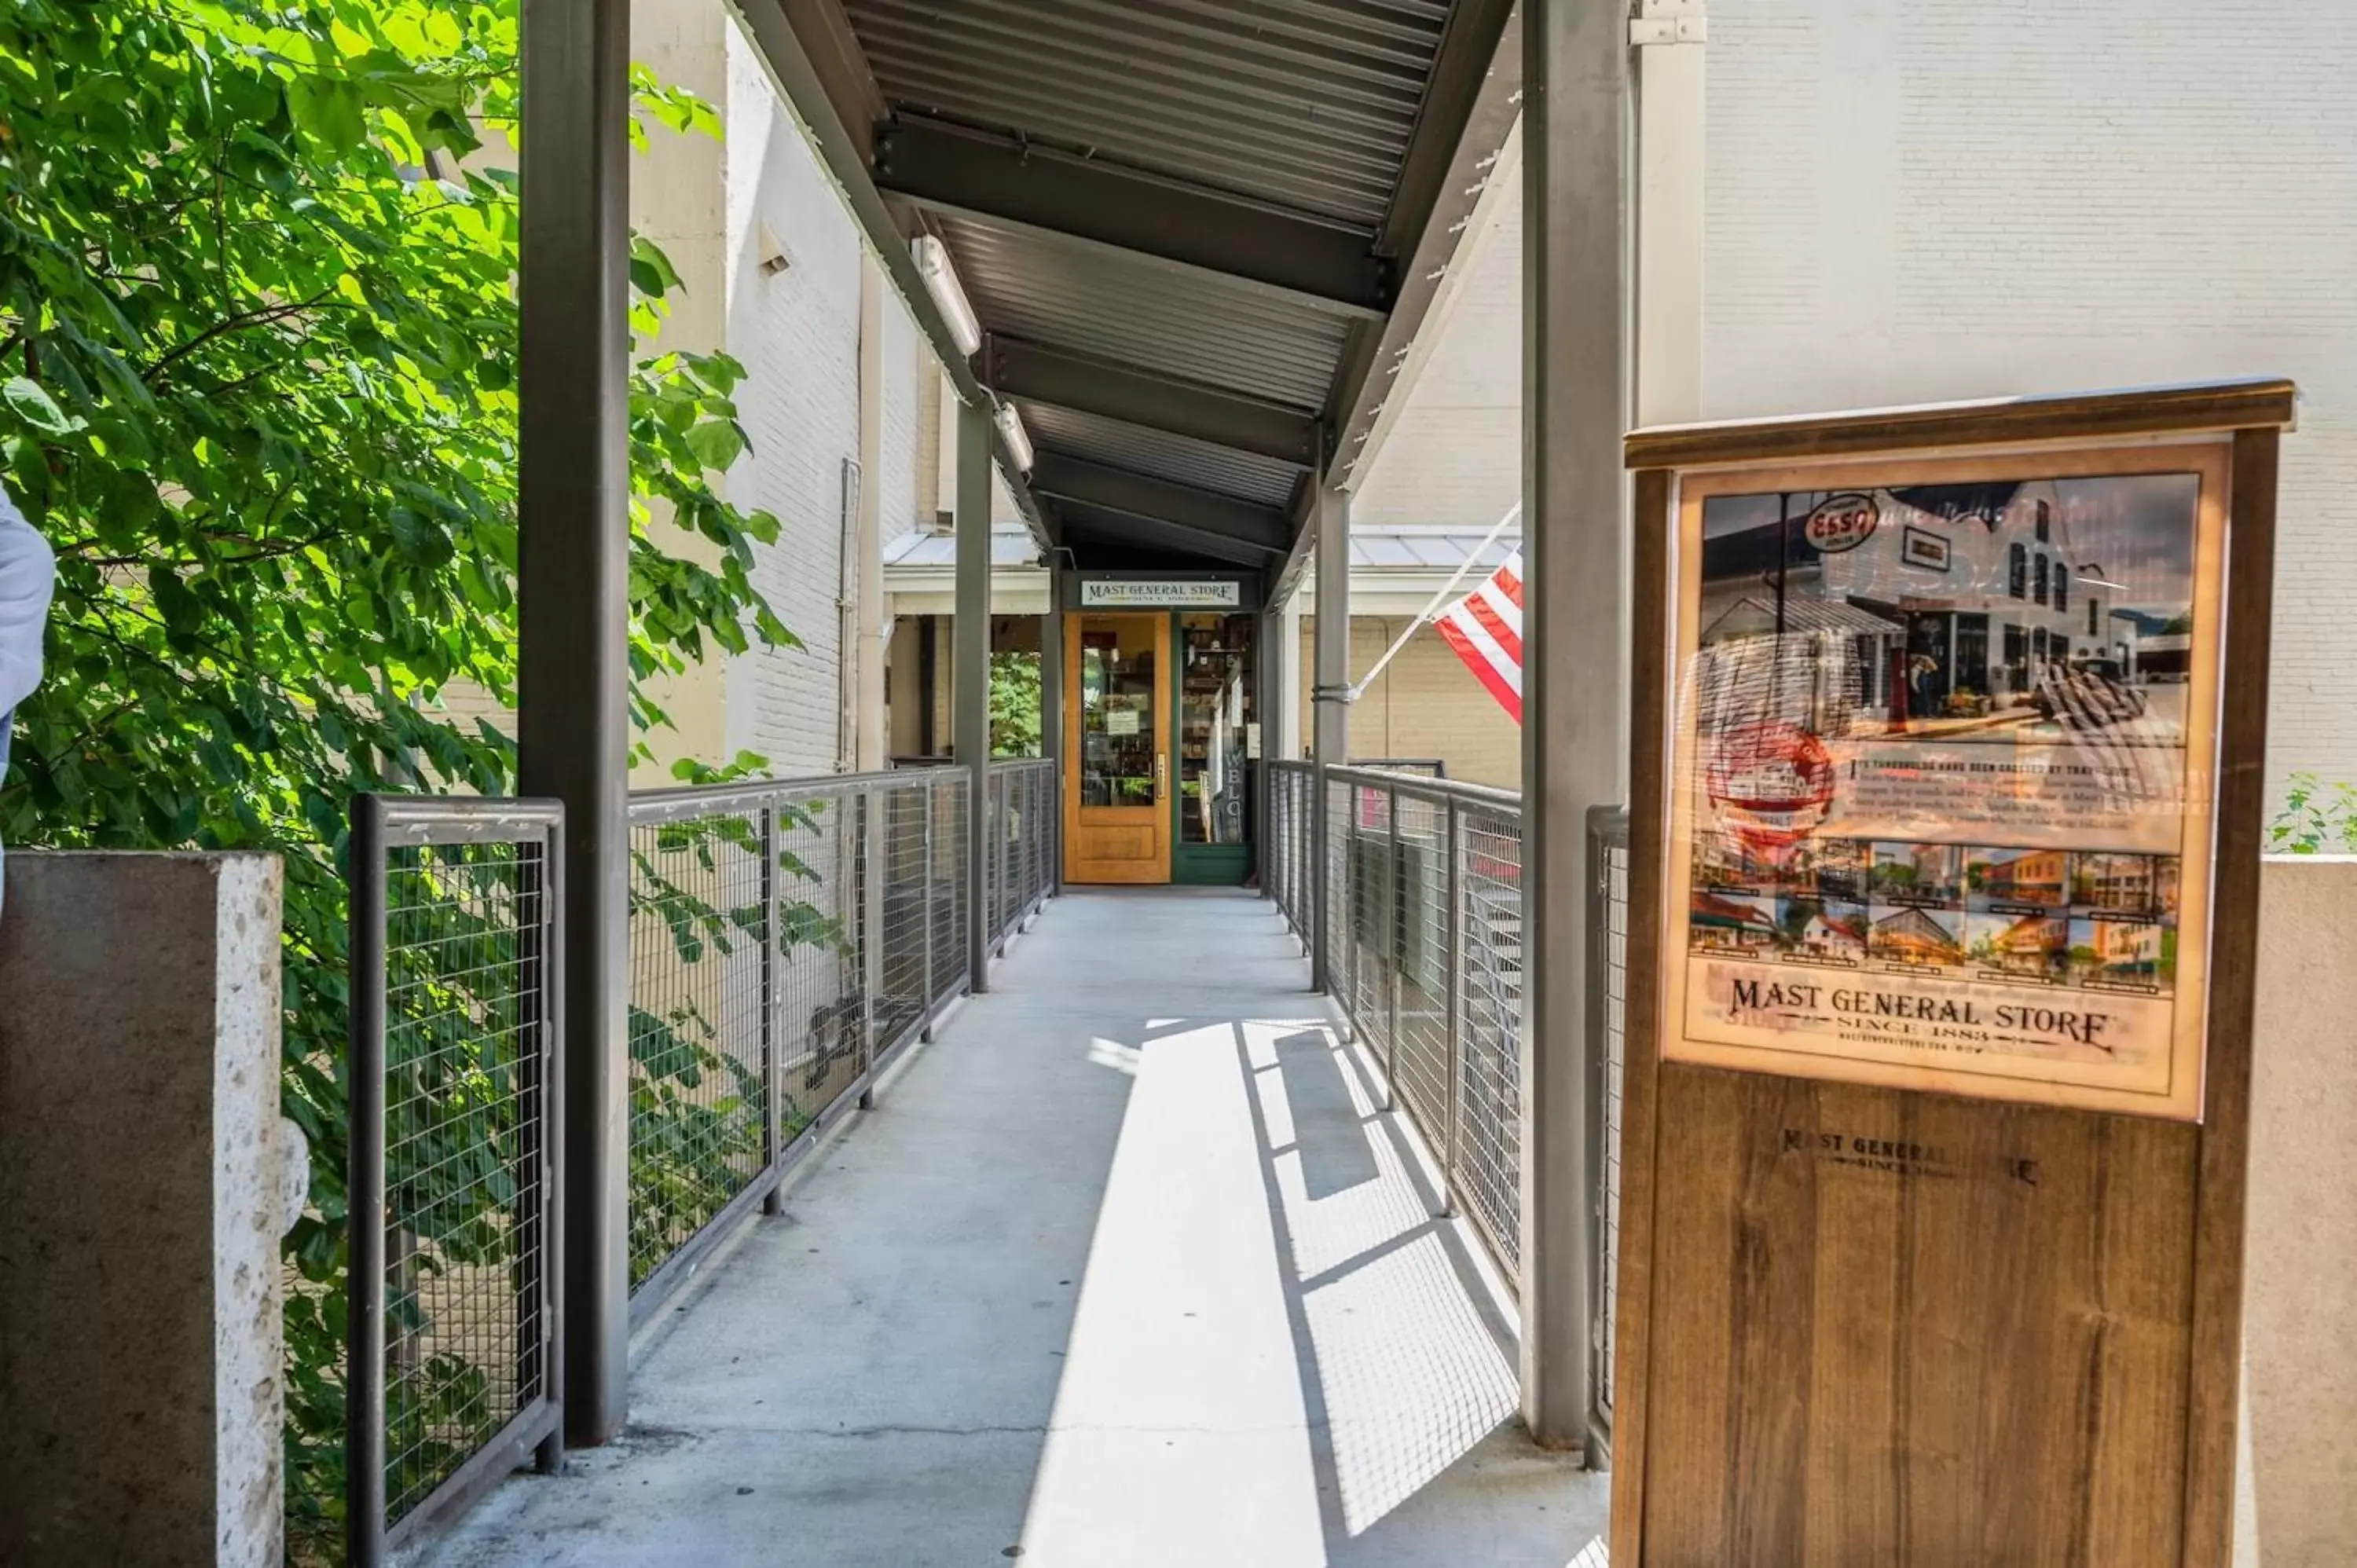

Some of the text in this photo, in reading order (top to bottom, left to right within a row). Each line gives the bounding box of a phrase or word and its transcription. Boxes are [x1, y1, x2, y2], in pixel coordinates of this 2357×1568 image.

[1089, 584, 1126, 601] MAST
[1129, 584, 1186, 595] GENERAL
[1189, 585, 1232, 601] STORE
[1728, 979, 2113, 1053] MAST GENERAL STORE
[1837, 1017, 1989, 1042] SINCE 1883
